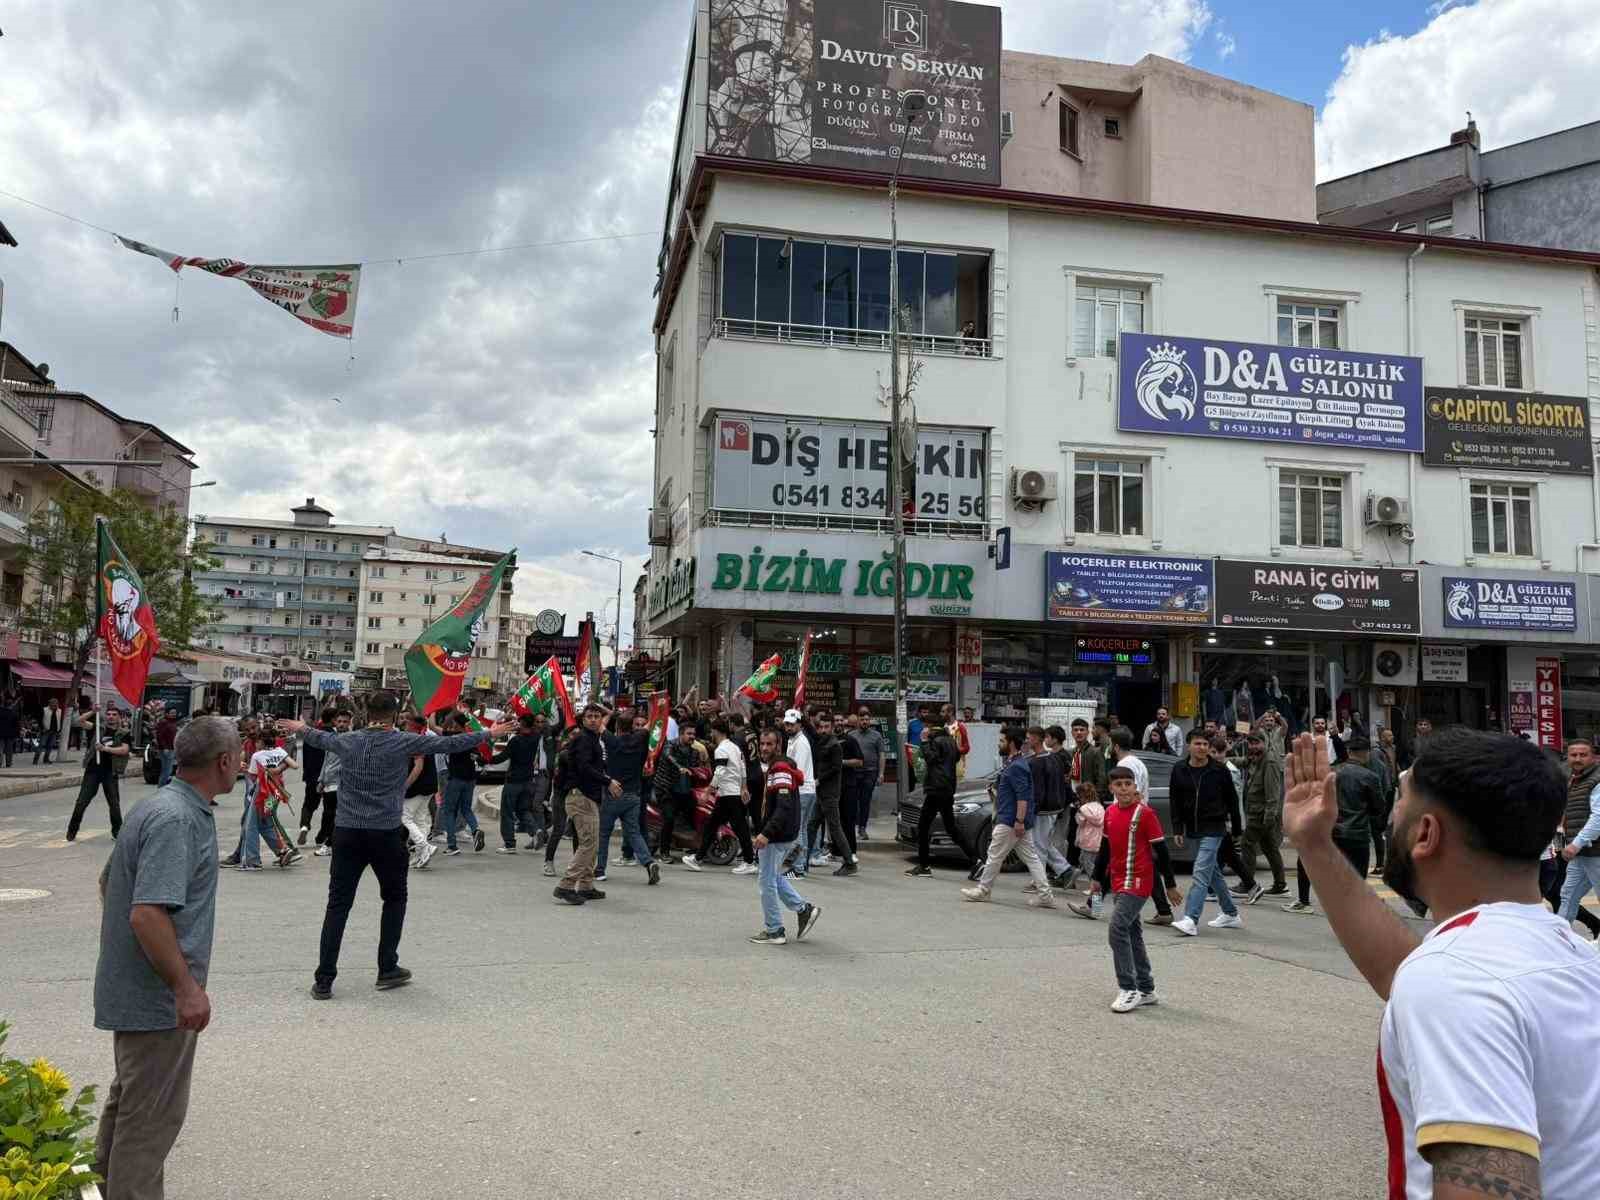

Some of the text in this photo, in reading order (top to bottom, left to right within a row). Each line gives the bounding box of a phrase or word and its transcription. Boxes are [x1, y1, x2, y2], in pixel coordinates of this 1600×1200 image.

[820, 39, 984, 81] DAVUT SERVAN
[816, 80, 985, 112] PROFESONEL
[1203, 346, 1406, 393] D&A GÜZELLİK
[1300, 377, 1395, 401] SALONU
[1444, 394, 1585, 428] CAPİTOL SİGORTA
[751, 427, 821, 476] DİŞ
[772, 484, 830, 507] 0541
[841, 486, 887, 510] 834
[920, 491, 949, 514] 25
[711, 546, 848, 594] BİZİM
[854, 550, 975, 600] IĞDIR
[1061, 556, 1126, 569] KOÇERLER
[1253, 568, 1306, 587] RANA
[1310, 567, 1327, 591] İÇ
[1331, 569, 1380, 591] GİYİM
[1477, 582, 1573, 604] D&A GÜZELLİK
[1522, 595, 1568, 606] SALONU
